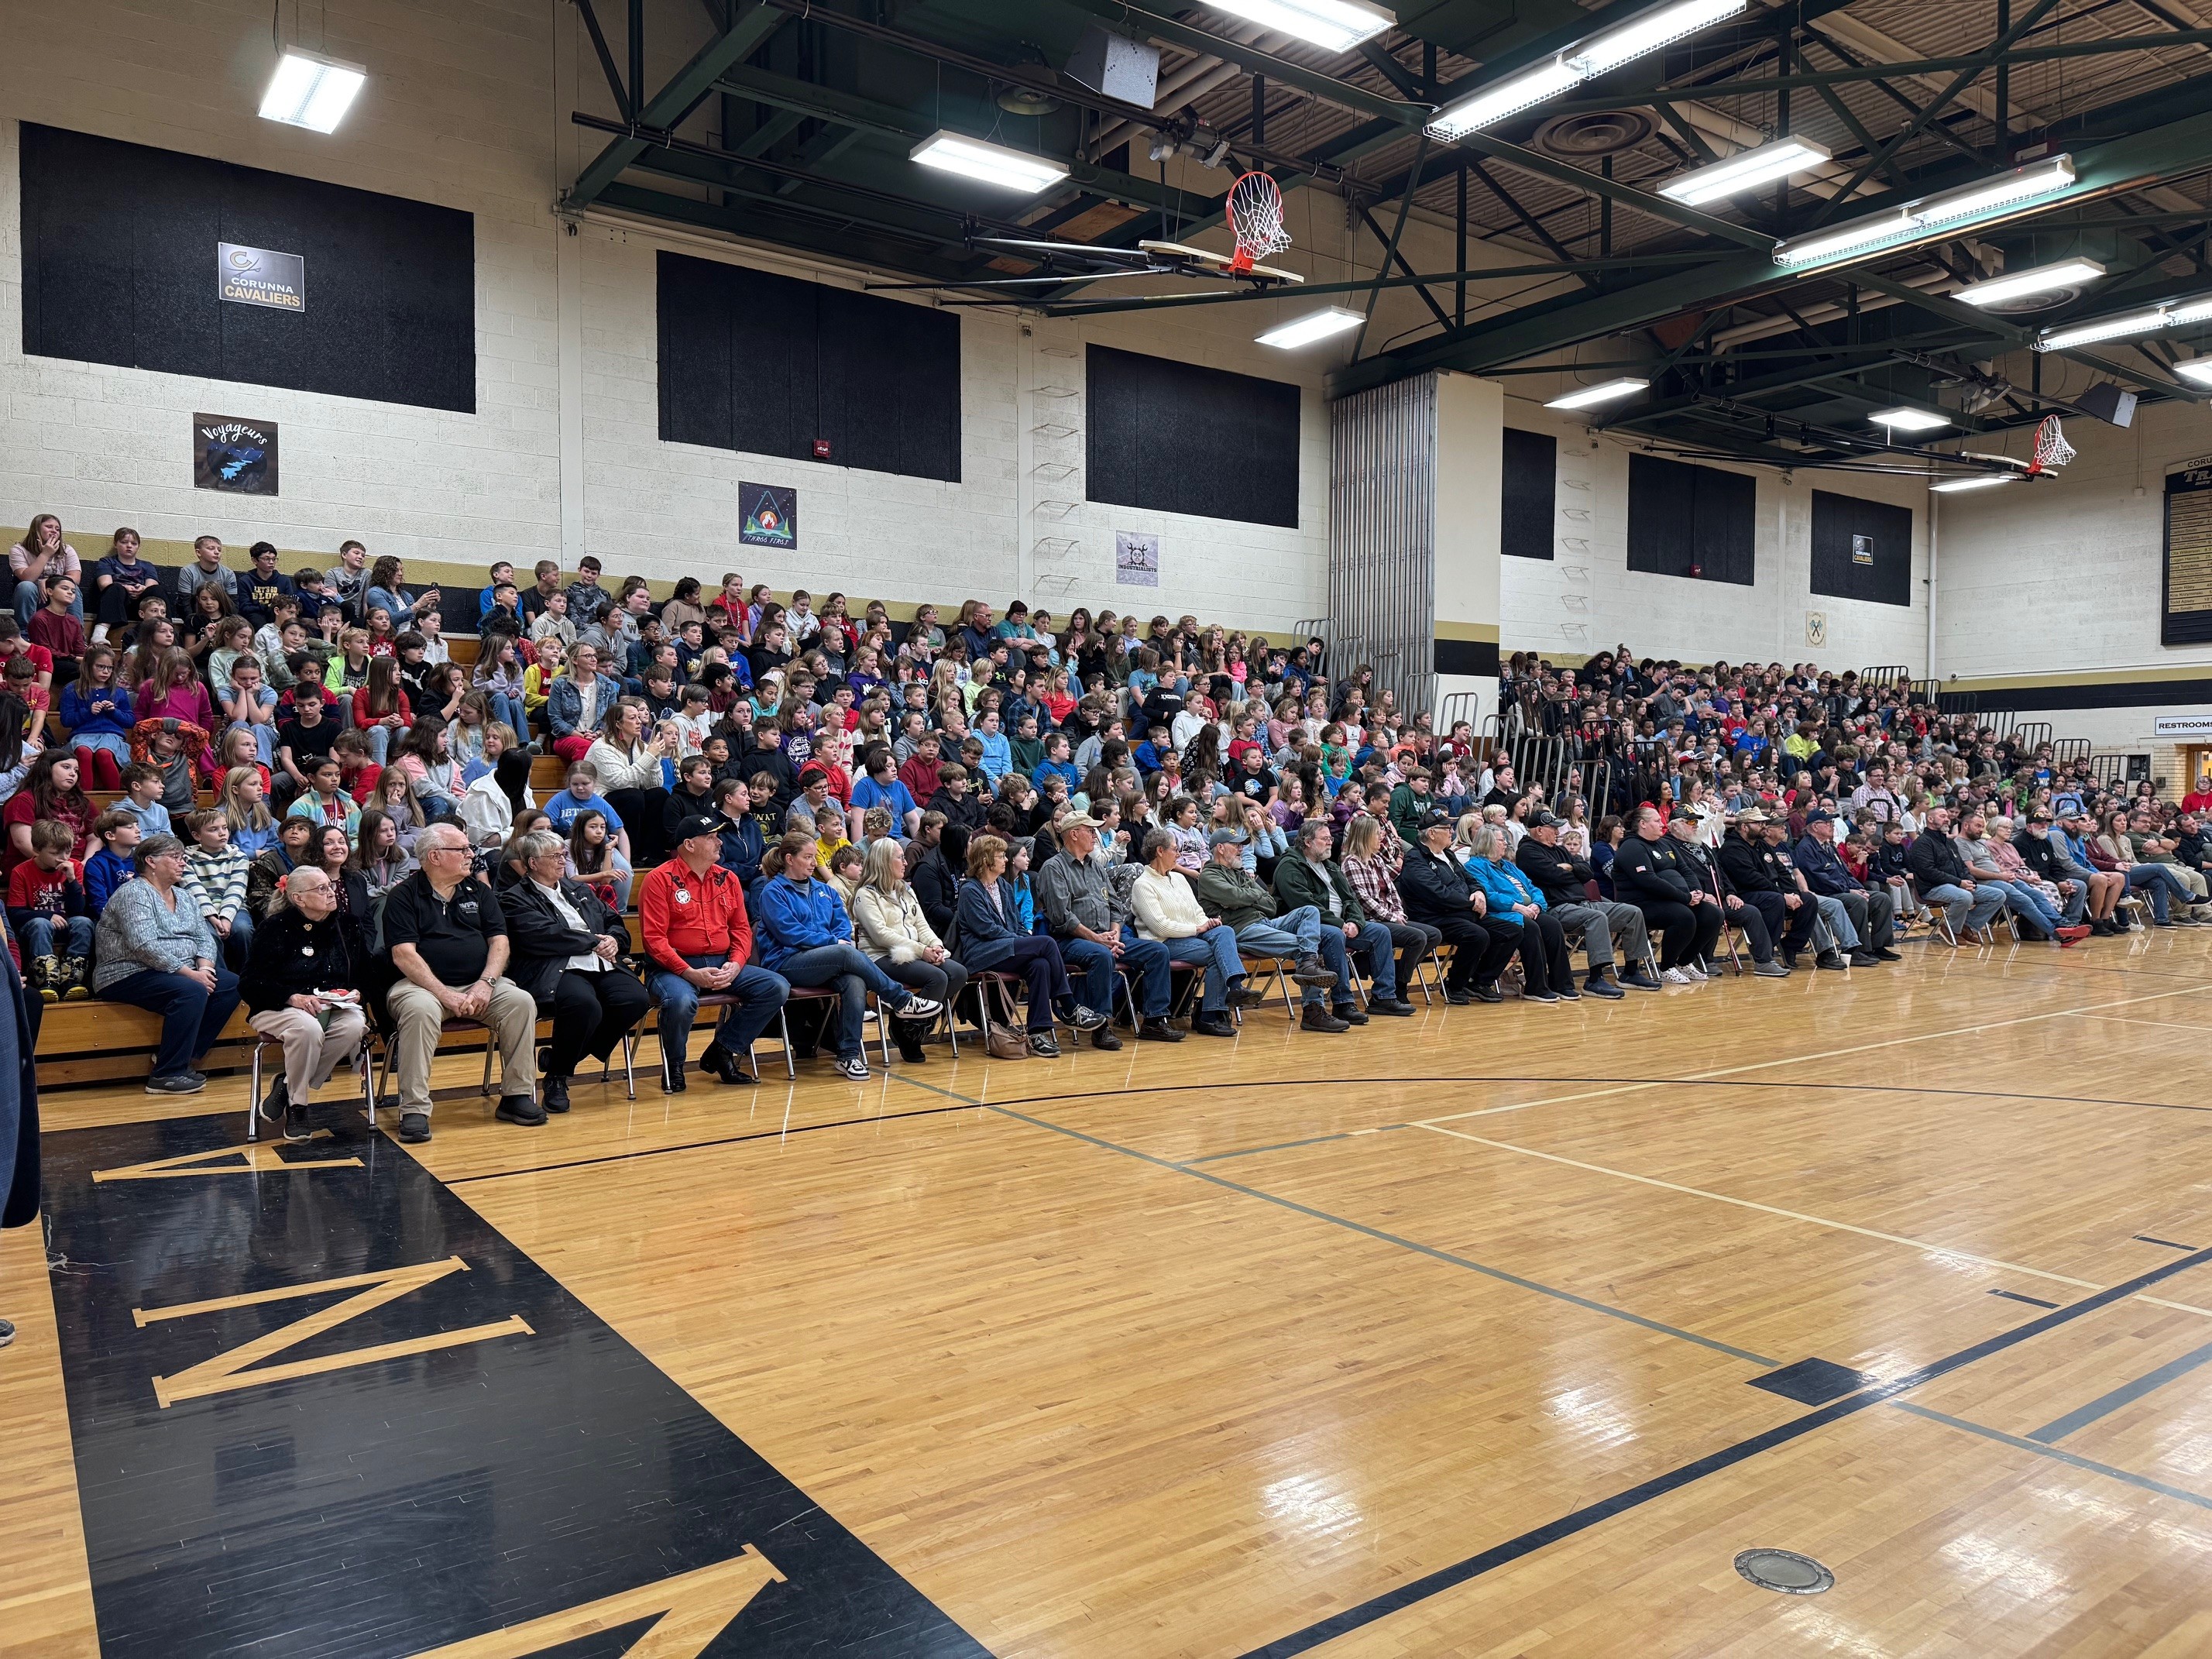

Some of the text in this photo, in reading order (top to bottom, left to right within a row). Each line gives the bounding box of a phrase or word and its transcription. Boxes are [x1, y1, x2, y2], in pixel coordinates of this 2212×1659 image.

[231, 277, 294, 294] CORUNNA
[225, 285, 301, 307] CAVALIERS
[201, 424, 268, 445] Voyageurs
[1118, 564, 1157, 572] INDUSTRIALISTS
